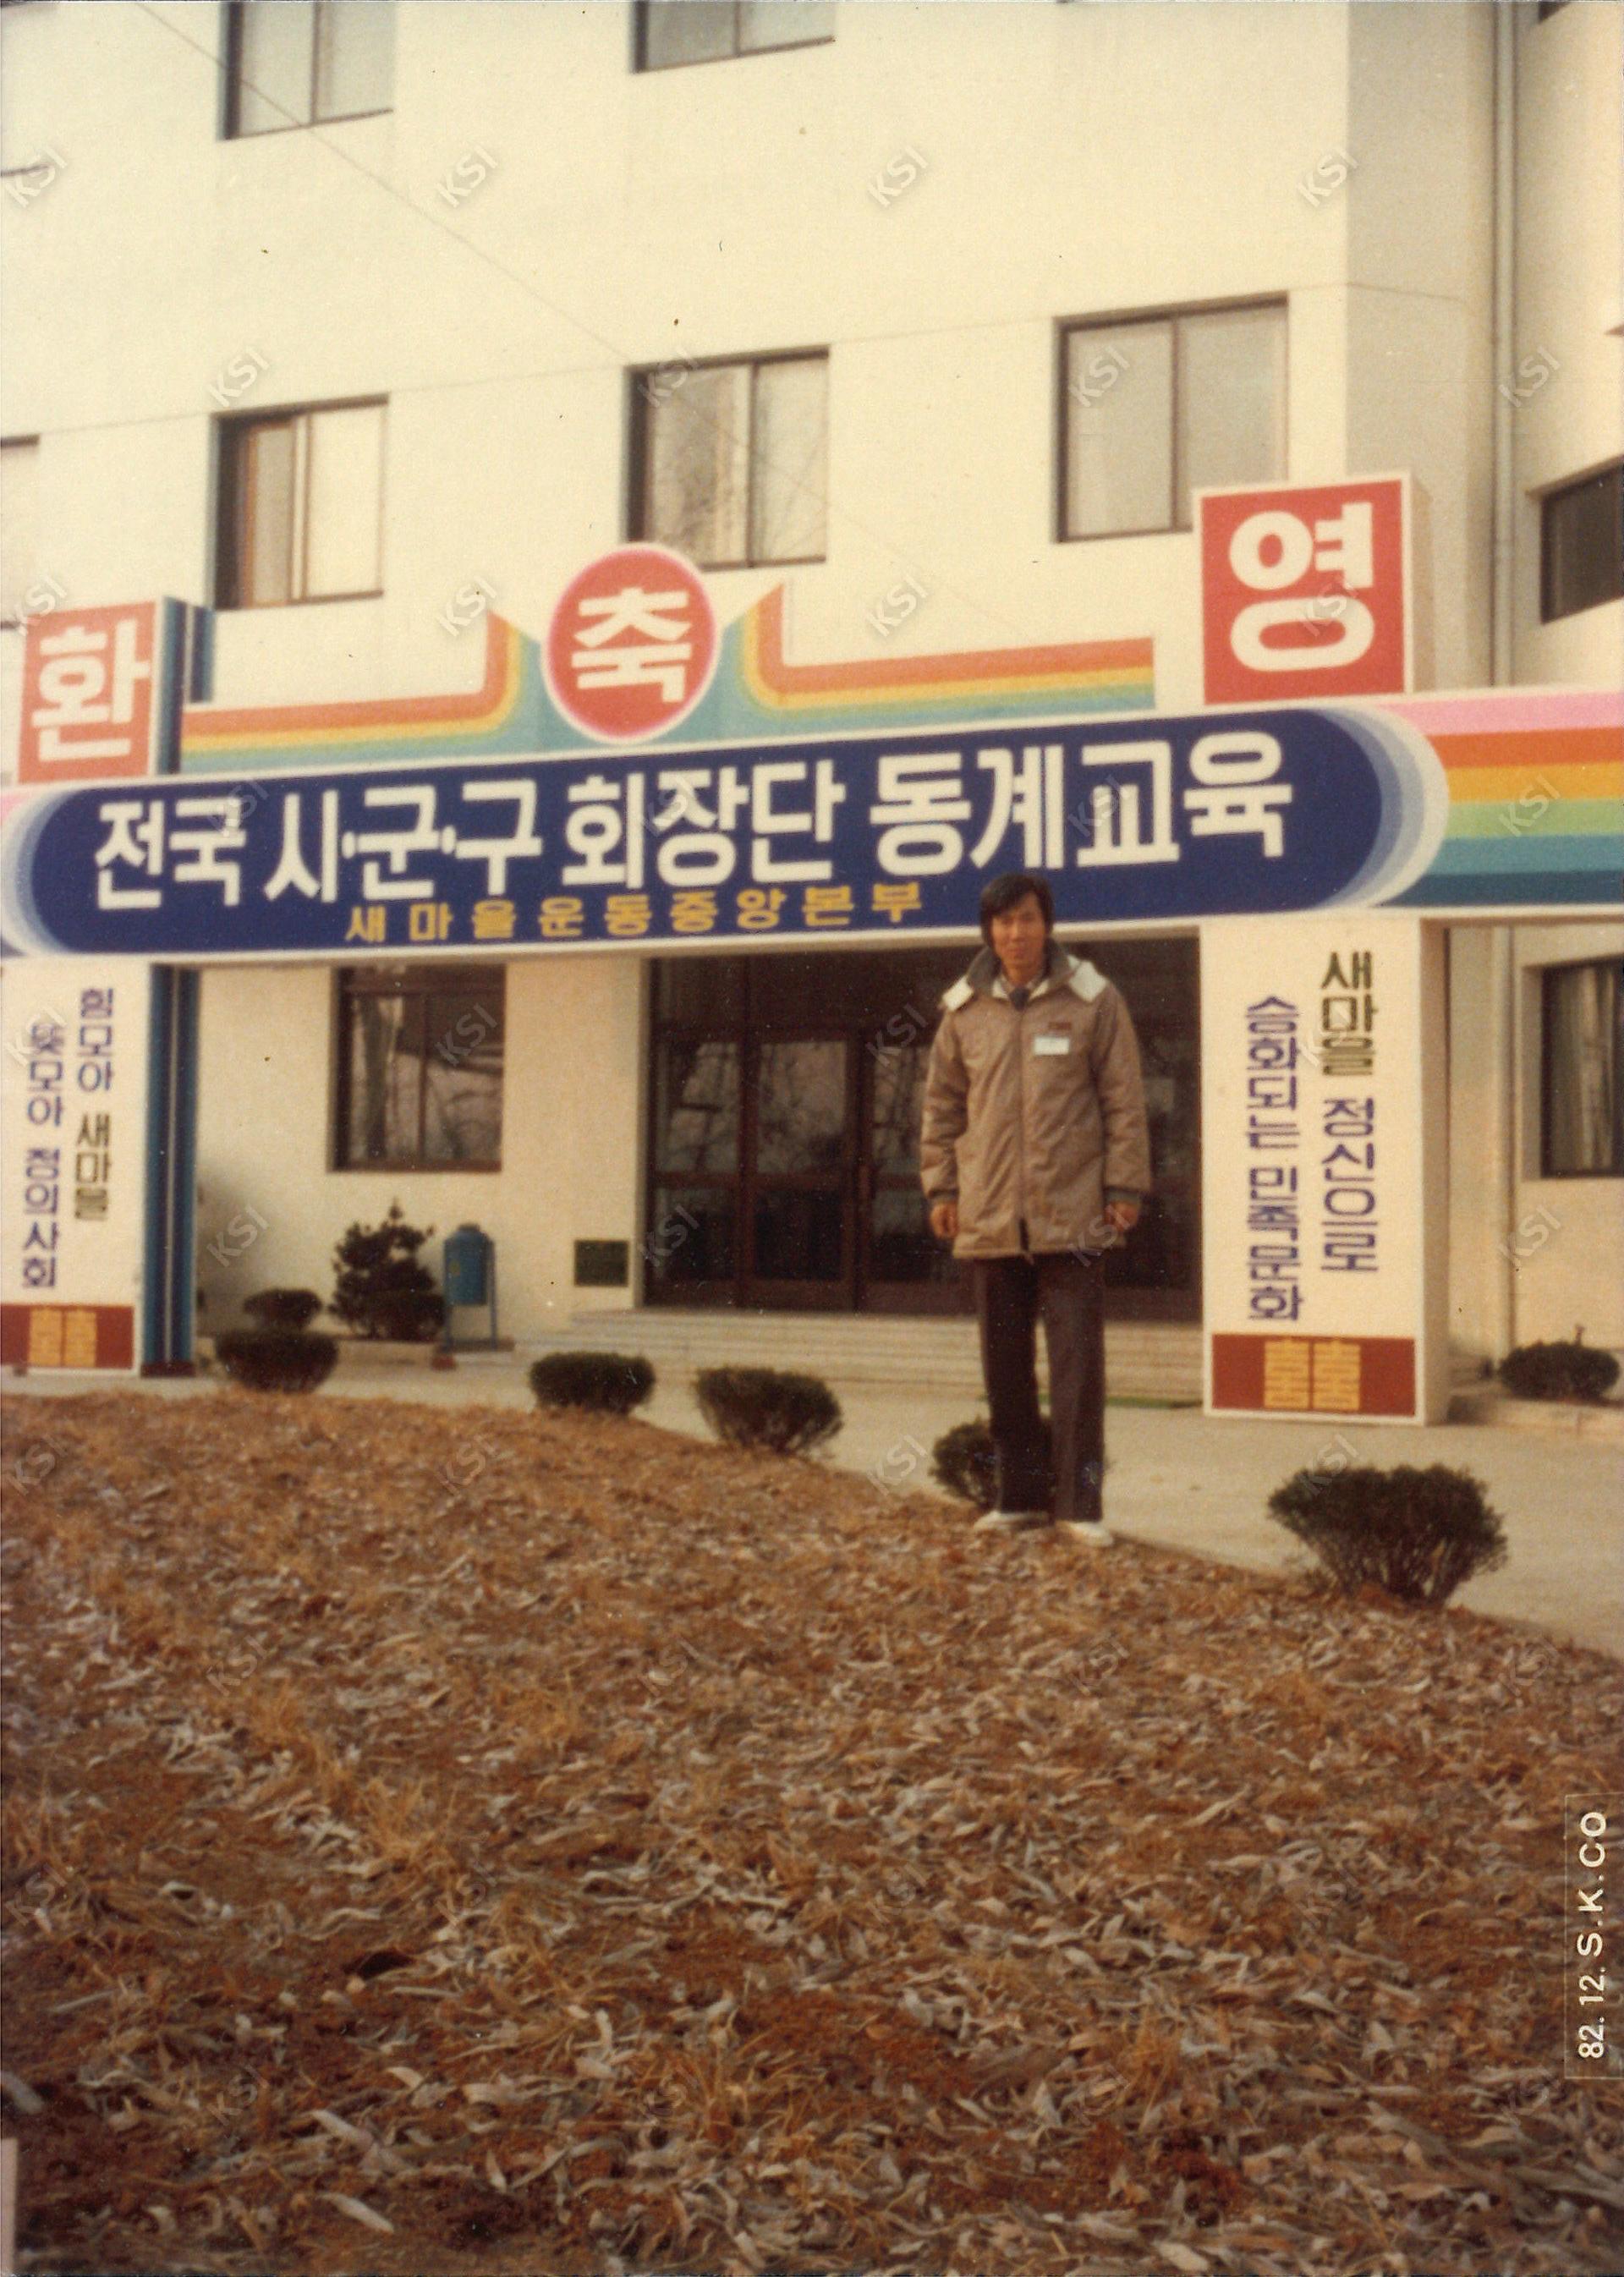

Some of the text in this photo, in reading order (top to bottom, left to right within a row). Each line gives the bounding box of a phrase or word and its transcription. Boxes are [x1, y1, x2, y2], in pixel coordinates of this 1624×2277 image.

[572, 587, 691, 704] 축
[1229, 502, 1375, 673] 영
[30, 618, 152, 763] 환
[95, 797, 247, 912] 전국
[562, 752, 846, 891] 회장단
[870, 730, 1293, 876] 동계교육
[74, 988, 113, 1221] 힘모아 새마을
[1245, 995, 1304, 1321] 승화되는 민족문화
[1320, 950, 1379, 1272] 새마을 정신으로
[22, 1149, 60, 1288] 정의사회
